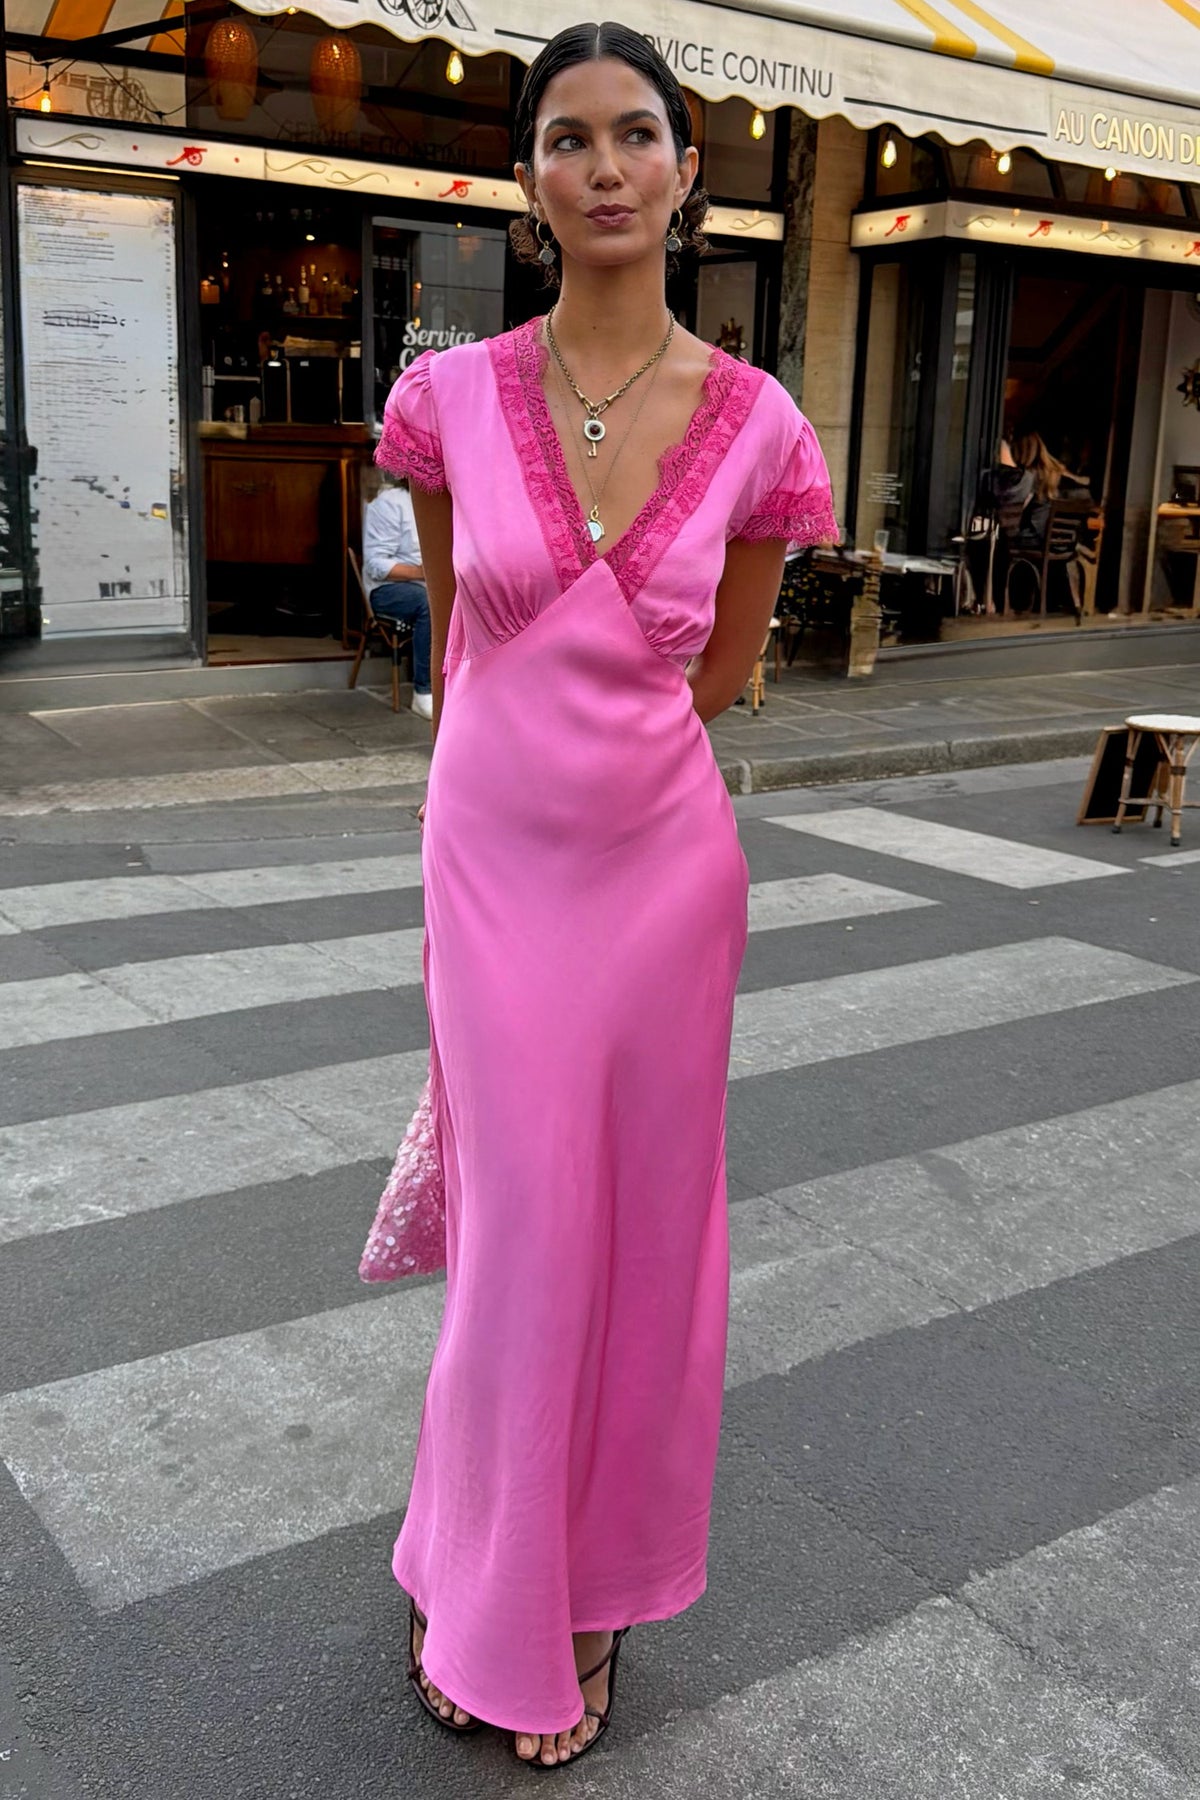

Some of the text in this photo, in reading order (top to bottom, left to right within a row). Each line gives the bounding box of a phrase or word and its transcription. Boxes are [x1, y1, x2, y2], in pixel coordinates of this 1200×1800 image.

[722, 51, 833, 98] CONTINU
[1054, 109, 1085, 145] AU
[1090, 112, 1175, 162] CANON
[402, 321, 476, 347] Service
